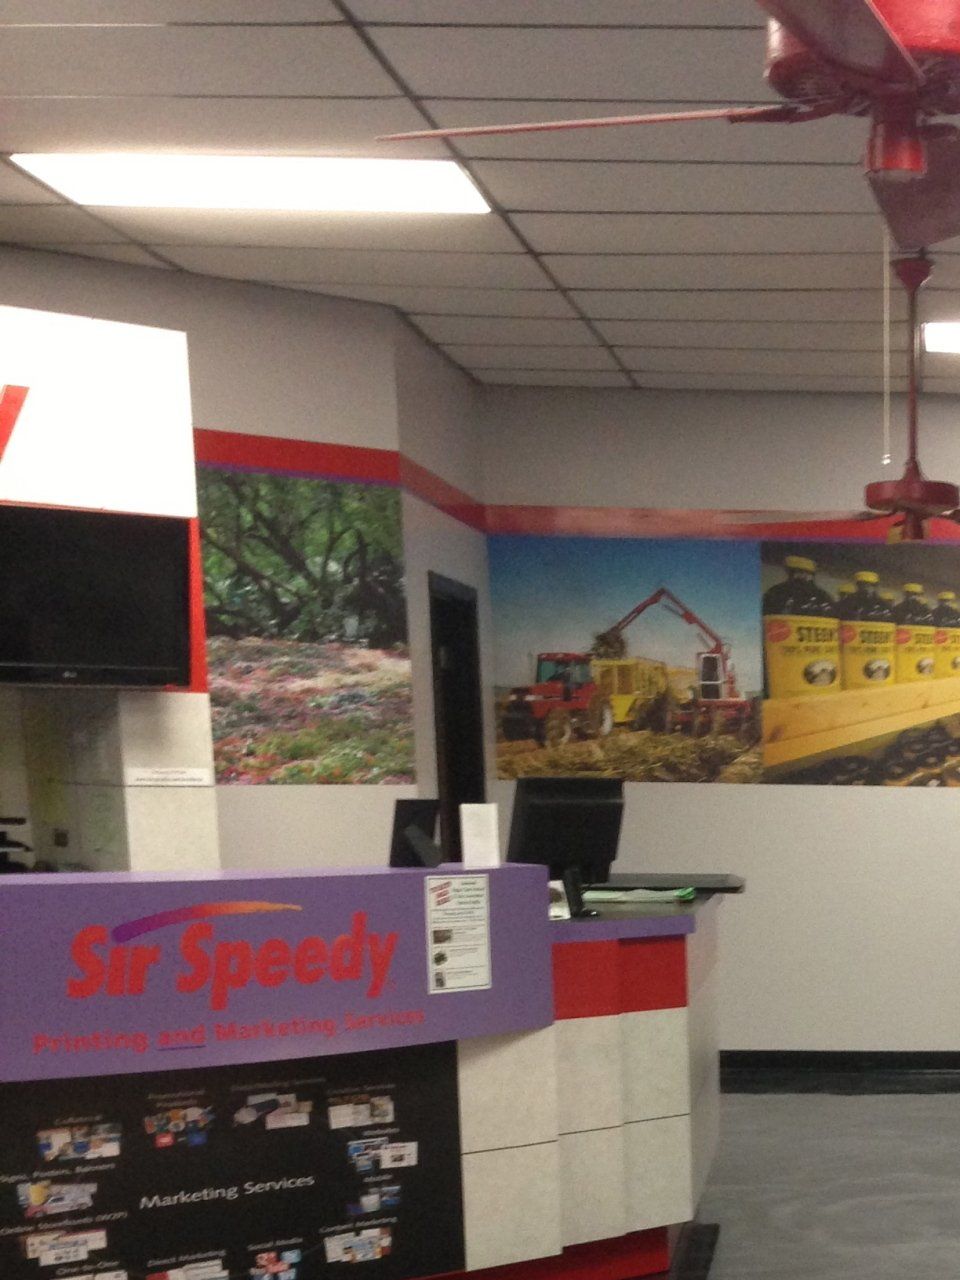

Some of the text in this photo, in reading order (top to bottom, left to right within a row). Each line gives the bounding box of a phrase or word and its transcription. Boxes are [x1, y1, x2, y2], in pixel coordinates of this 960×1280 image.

[66, 911, 399, 1011] Sir Speedy
[32, 1030, 149, 1055] Printing
[157, 1024, 206, 1046] and
[213, 1016, 337, 1041] Marketing
[139, 1176, 316, 1209] Marketing Services
